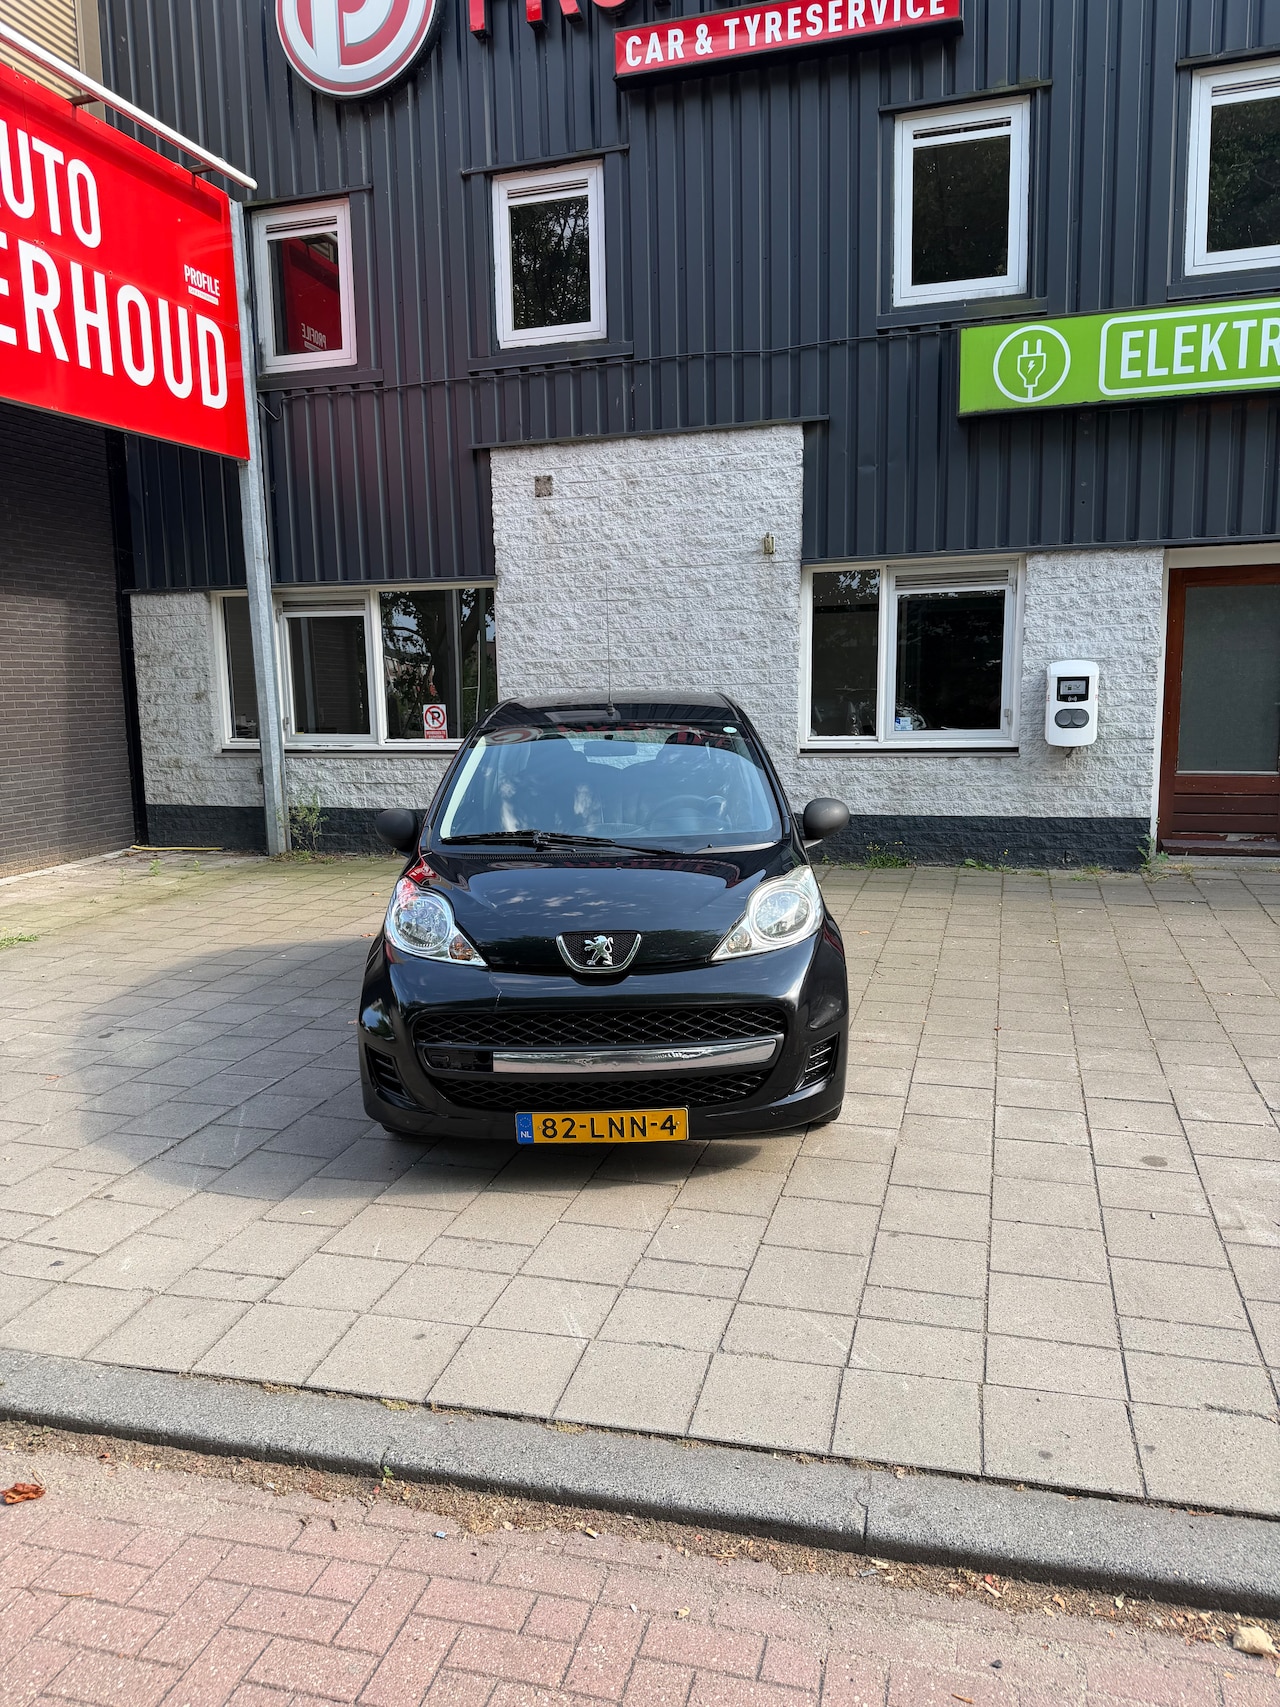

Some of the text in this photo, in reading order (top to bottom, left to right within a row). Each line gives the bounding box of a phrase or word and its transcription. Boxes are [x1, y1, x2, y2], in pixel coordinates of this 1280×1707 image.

[625, 28, 685, 67] CAR
[695, 23, 713, 55] &
[0, 118, 102, 249] UTO
[184, 263, 221, 297] PROFILE
[1120, 317, 1280, 380] ELEKTR
[520, 1114, 677, 1139] NL 82-LNN-4
